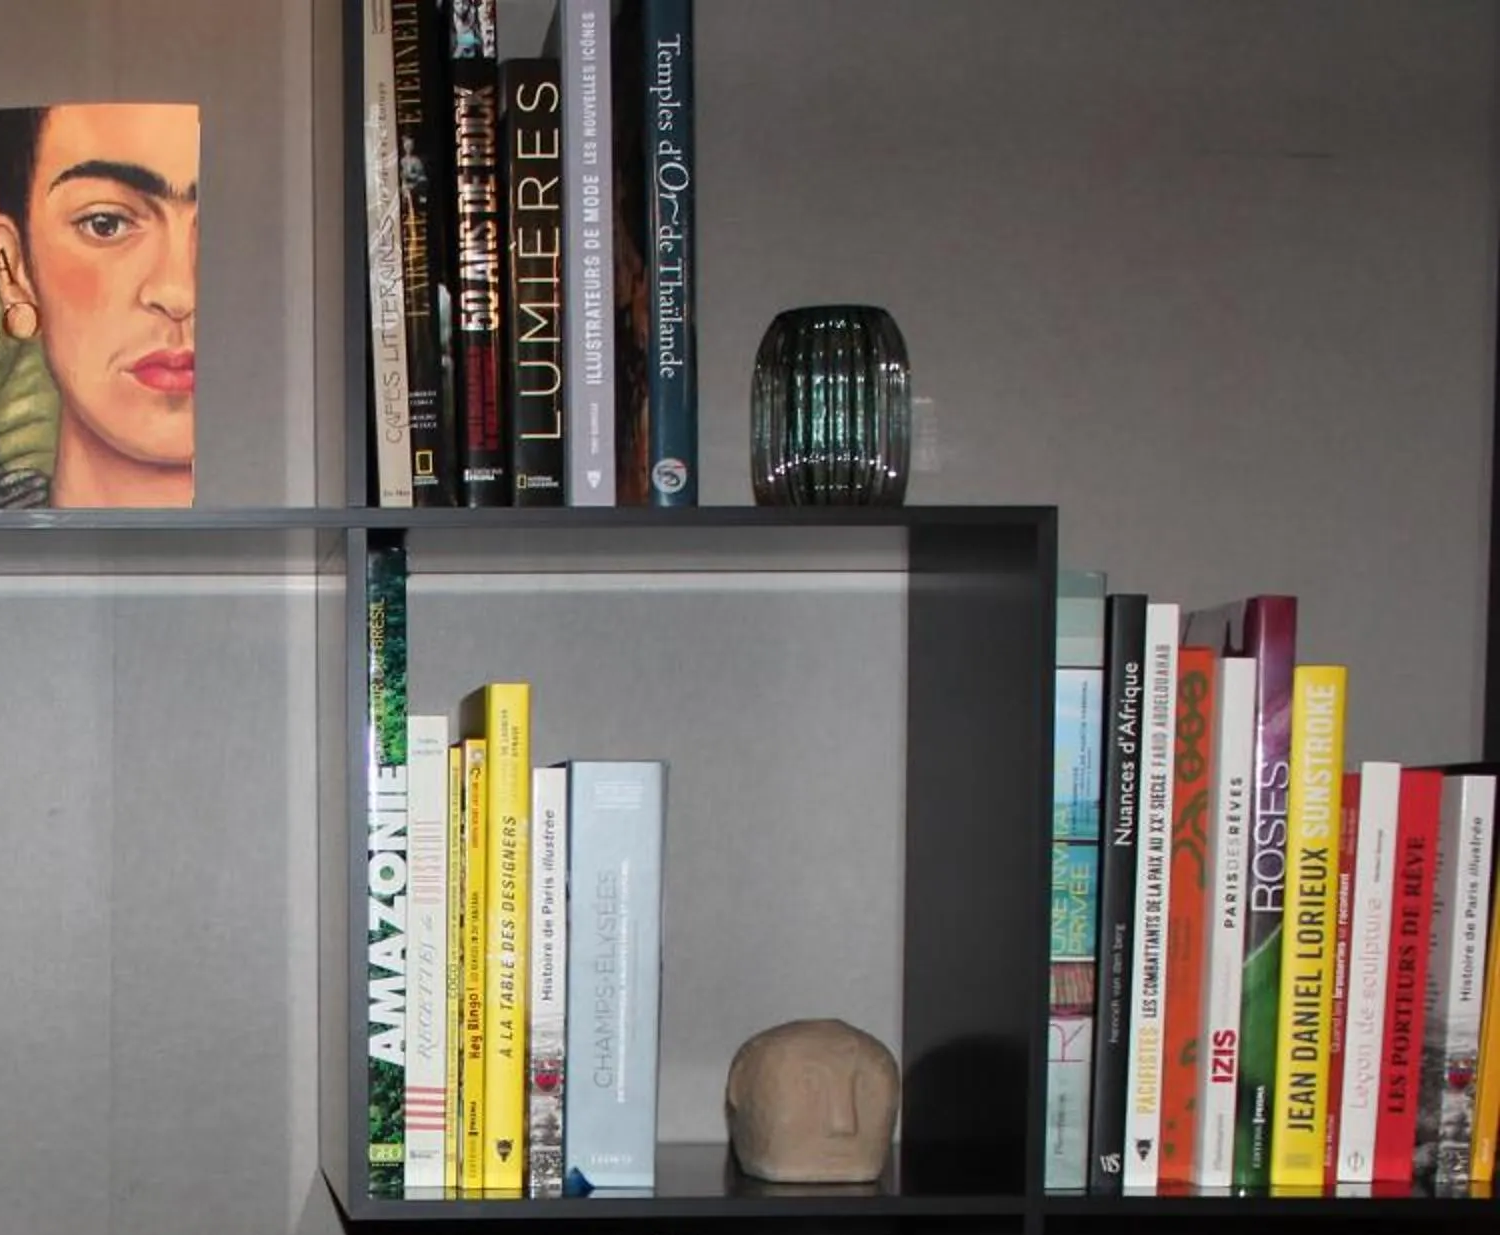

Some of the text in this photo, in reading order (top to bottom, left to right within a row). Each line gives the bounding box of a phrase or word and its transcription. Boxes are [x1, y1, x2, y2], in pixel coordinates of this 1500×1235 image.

[581, 65, 597, 136] NOUVELLES
[649, 33, 682, 130] Temples
[454, 85, 494, 166] ROCK
[582, 142, 597, 165] LES
[459, 175, 496, 212] DE
[582, 175, 600, 222] MODE
[458, 221, 498, 282] ANS
[510, 79, 561, 440] LUMIÈRES
[584, 227, 600, 249] DE
[660, 224, 681, 253] de
[460, 292, 500, 331] 50
[585, 255, 602, 385] ILLUSTRATEURS
[659, 258, 682, 378] Thaïlande
[1112, 661, 1142, 846] Nuances d'Afrique
[1250, 760, 1290, 913] ROSES
[367, 763, 408, 1067] AMAZONIE
[539, 809, 556, 1001] Histoire de Paris illustrée
[1285, 683, 1337, 1134] JEAN DANIEL LORIEUX SUNSTROKE
[1463, 921, 1477, 937] de
[1465, 881, 1480, 918] Paris
[1349, 898, 1385, 1111] Leçon de sculpture
[1385, 835, 1425, 1115] LES PORTEURS DE RÊVE
[1460, 942, 1477, 1002] Histoire
[464, 986, 481, 1030] Bingo!
[468, 1034, 484, 1059] Hey
[1211, 1029, 1236, 1084] IZIS
